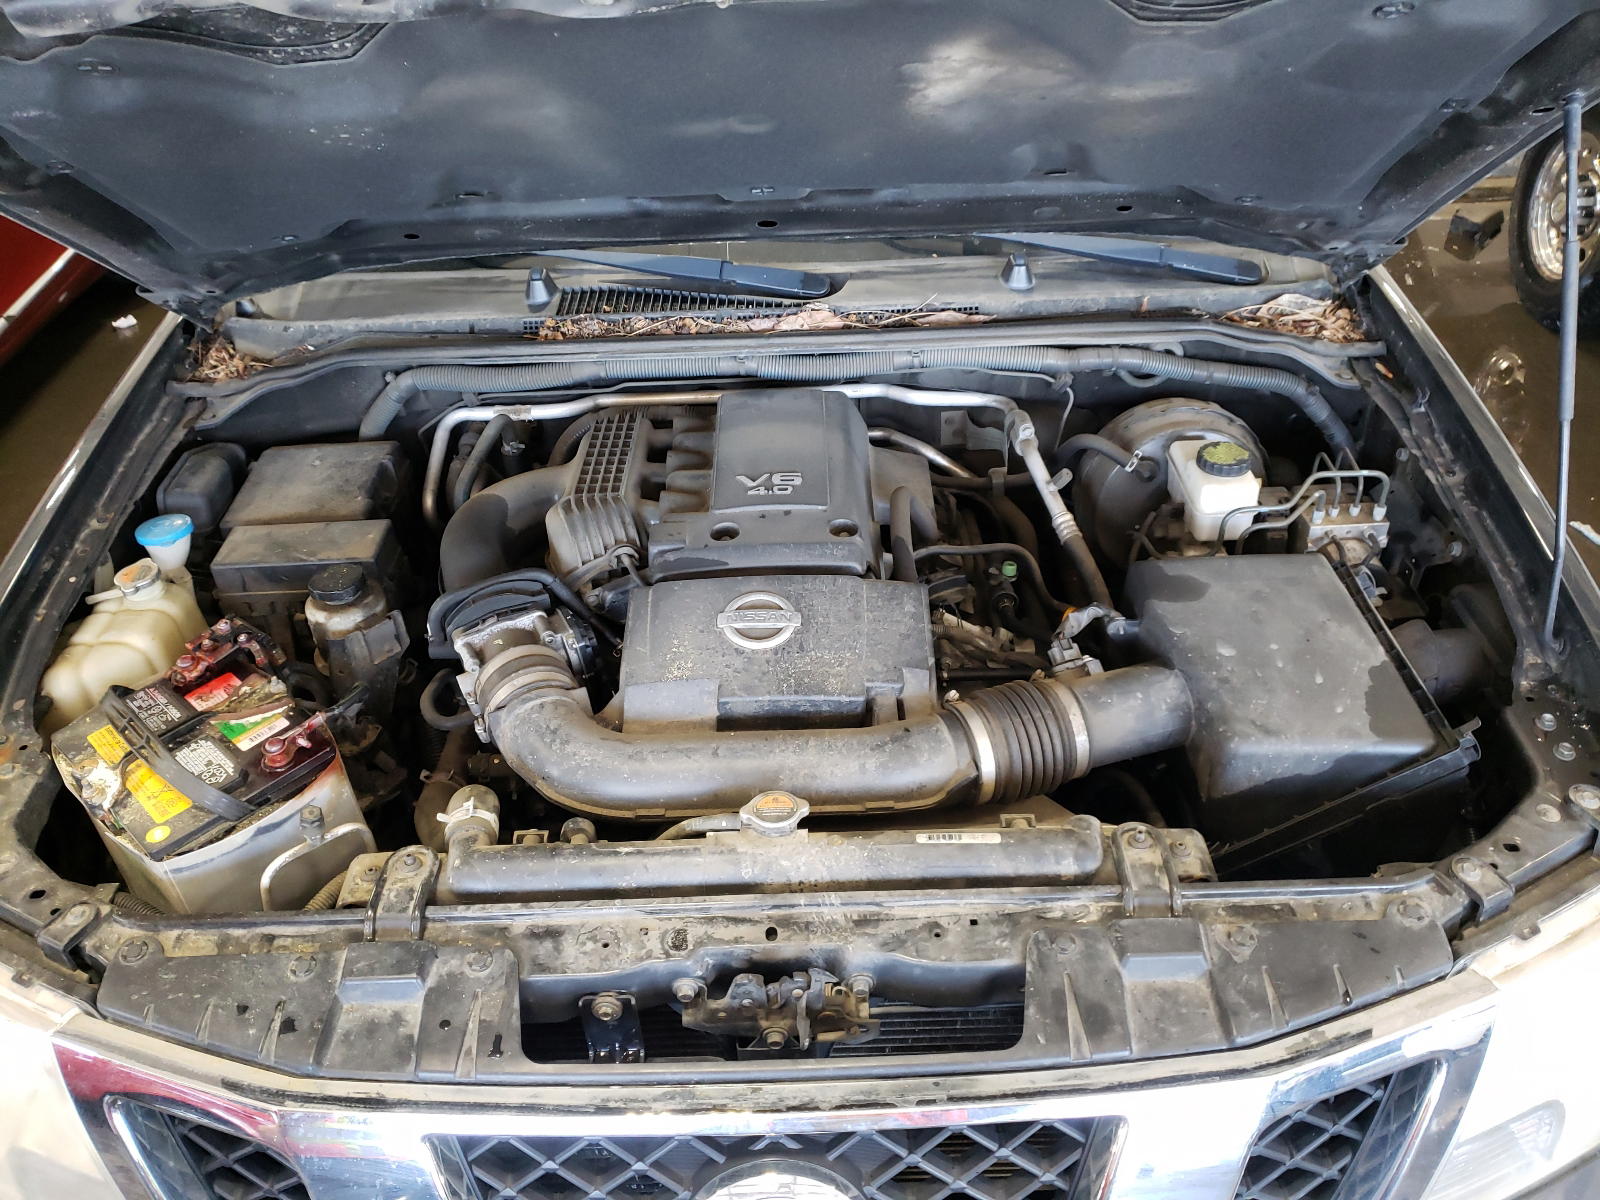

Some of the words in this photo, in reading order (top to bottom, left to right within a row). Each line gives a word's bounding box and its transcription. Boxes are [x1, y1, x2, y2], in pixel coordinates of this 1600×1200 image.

[735, 472, 803, 487] V6
[747, 486, 794, 496] 4.0
[725, 610, 793, 623] NISSAN
